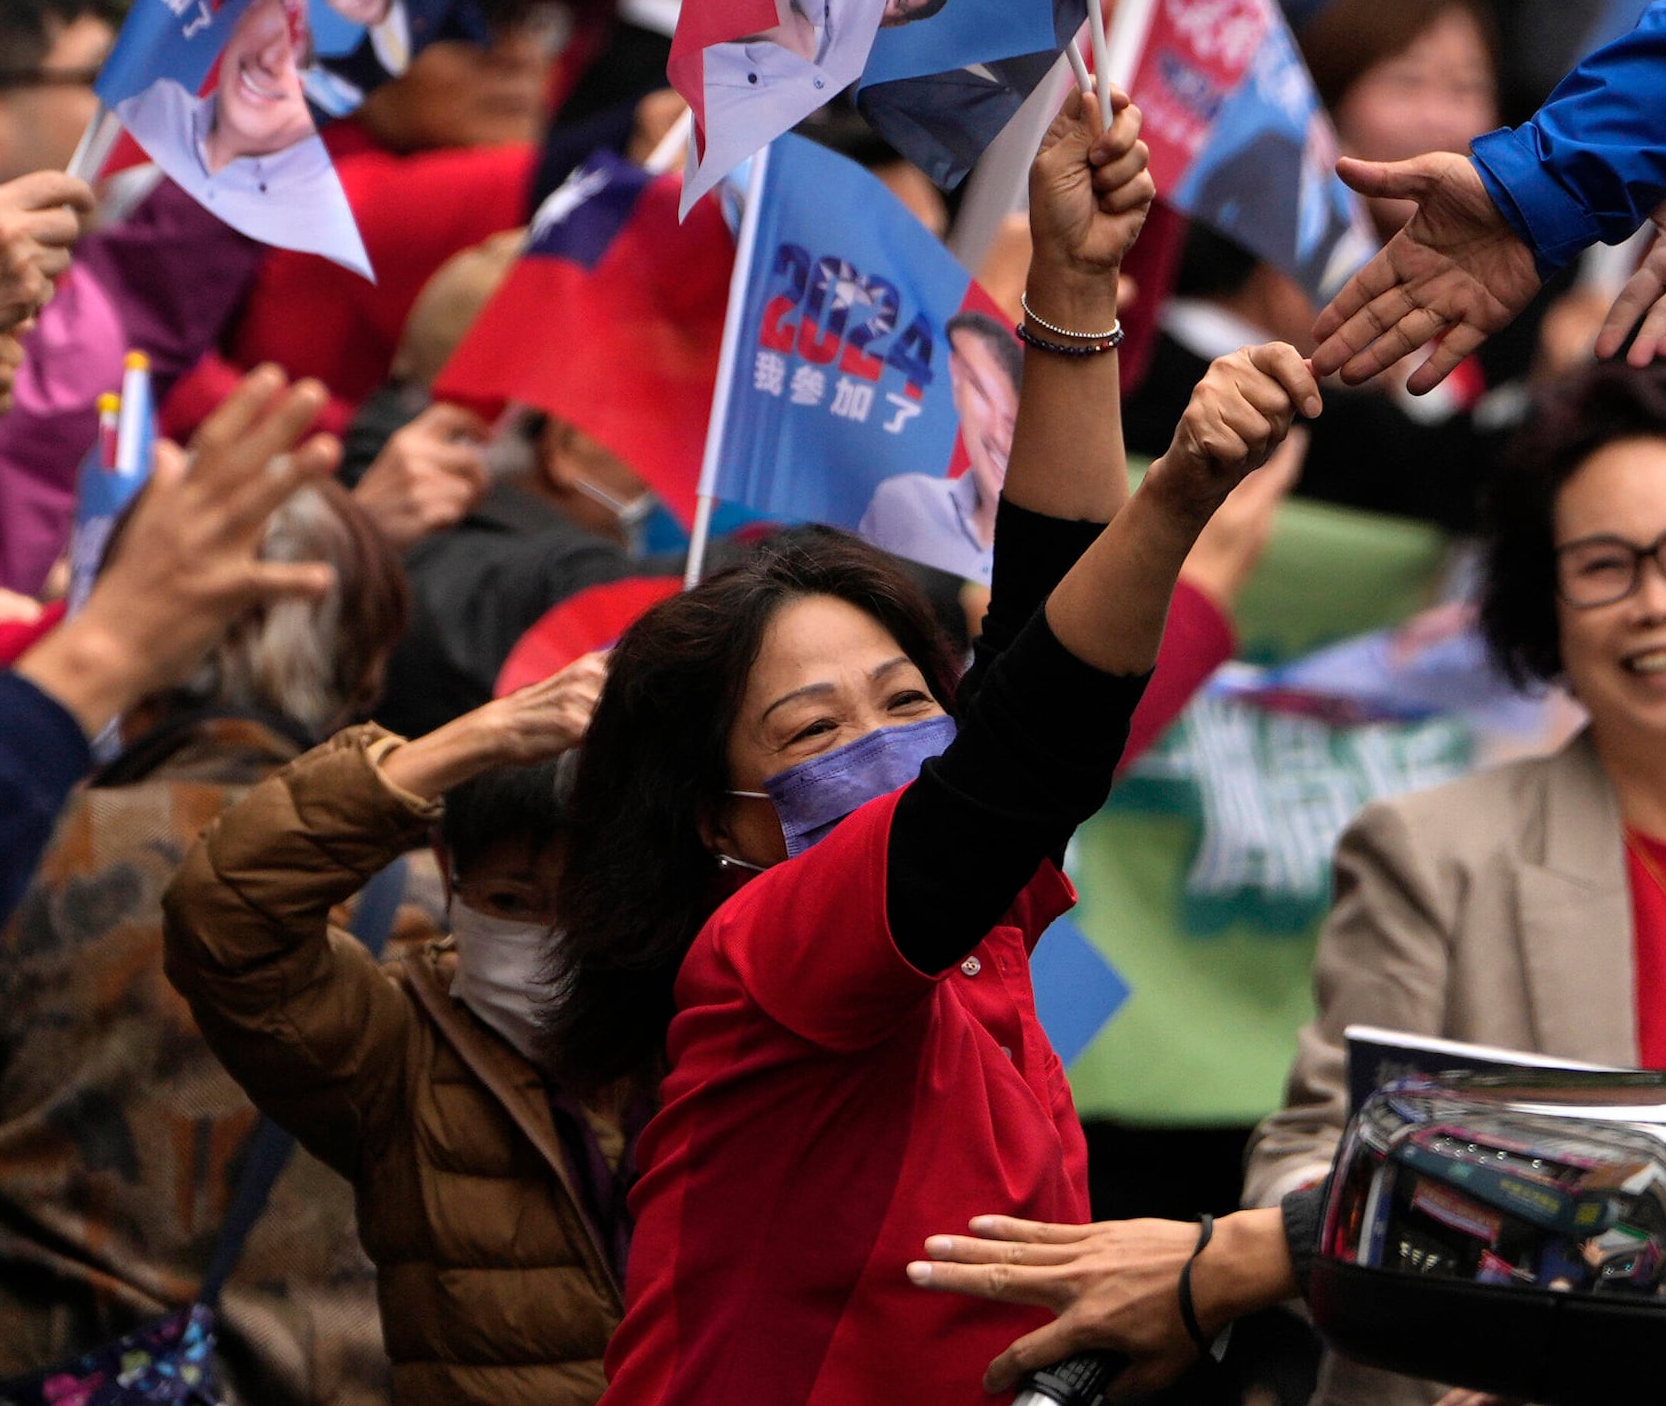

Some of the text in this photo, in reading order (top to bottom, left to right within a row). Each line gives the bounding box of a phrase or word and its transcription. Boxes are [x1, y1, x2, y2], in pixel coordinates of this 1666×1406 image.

[759, 242, 935, 402] 2024
[753, 350, 922, 435] 我參加了
